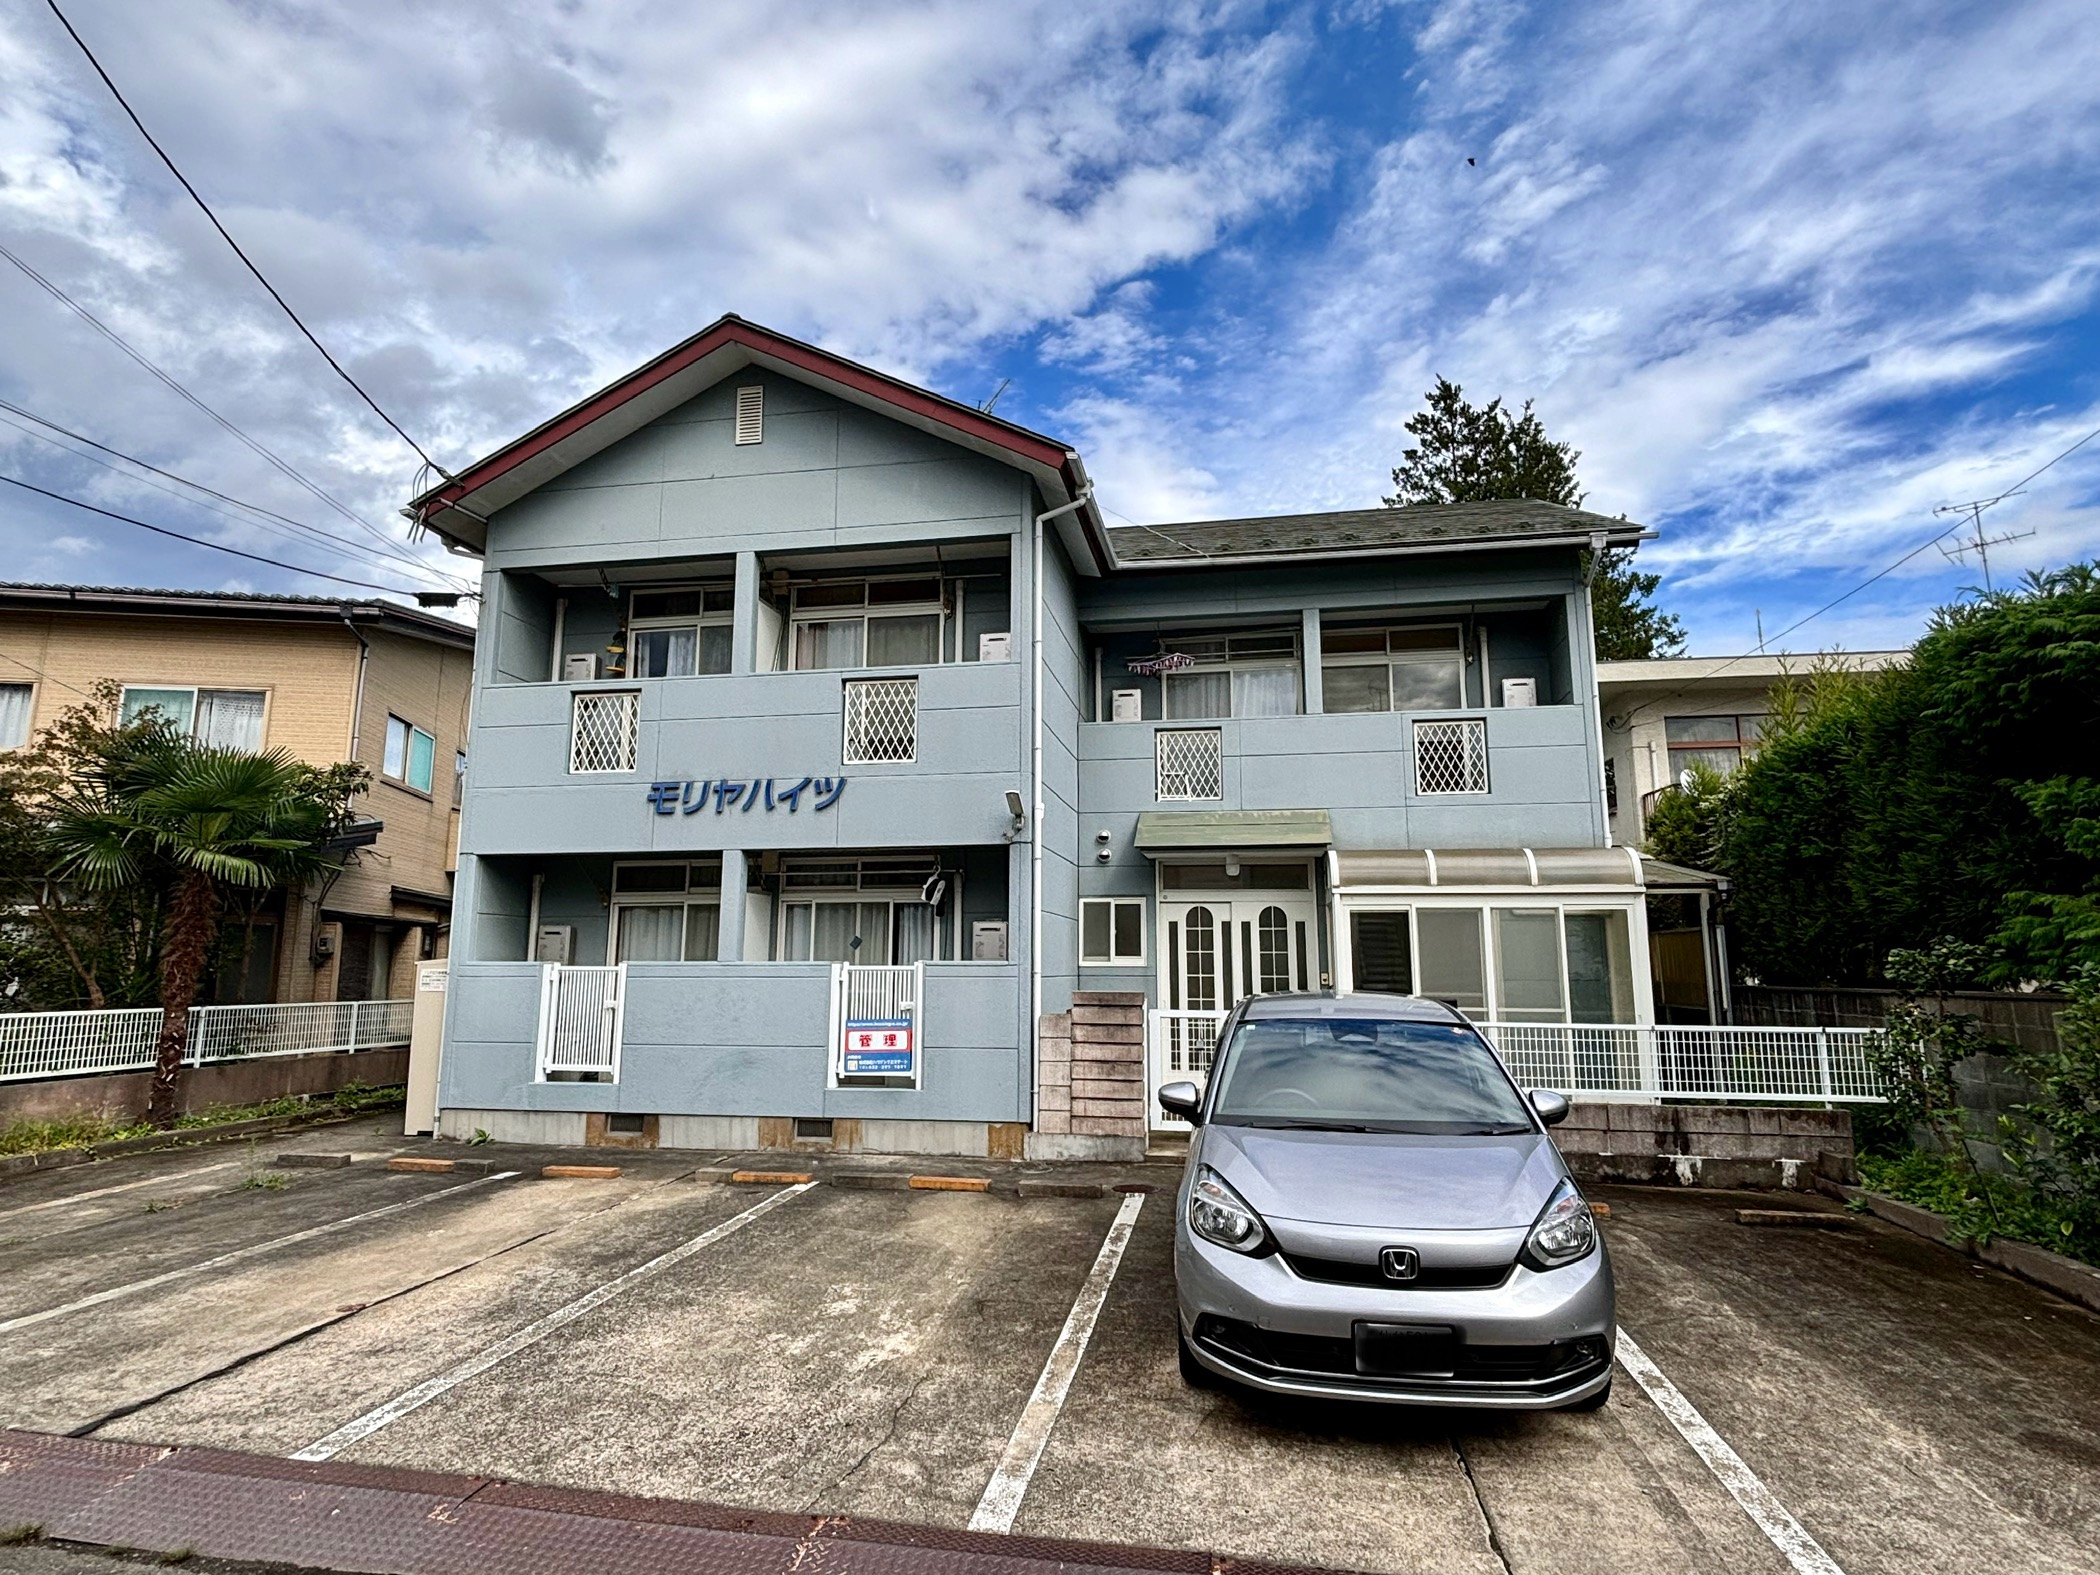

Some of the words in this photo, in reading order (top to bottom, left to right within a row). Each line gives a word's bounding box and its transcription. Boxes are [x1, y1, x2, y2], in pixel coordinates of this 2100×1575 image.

[647, 777, 847, 814] モリヤハイツ
[859, 1034, 897, 1047] 管理
